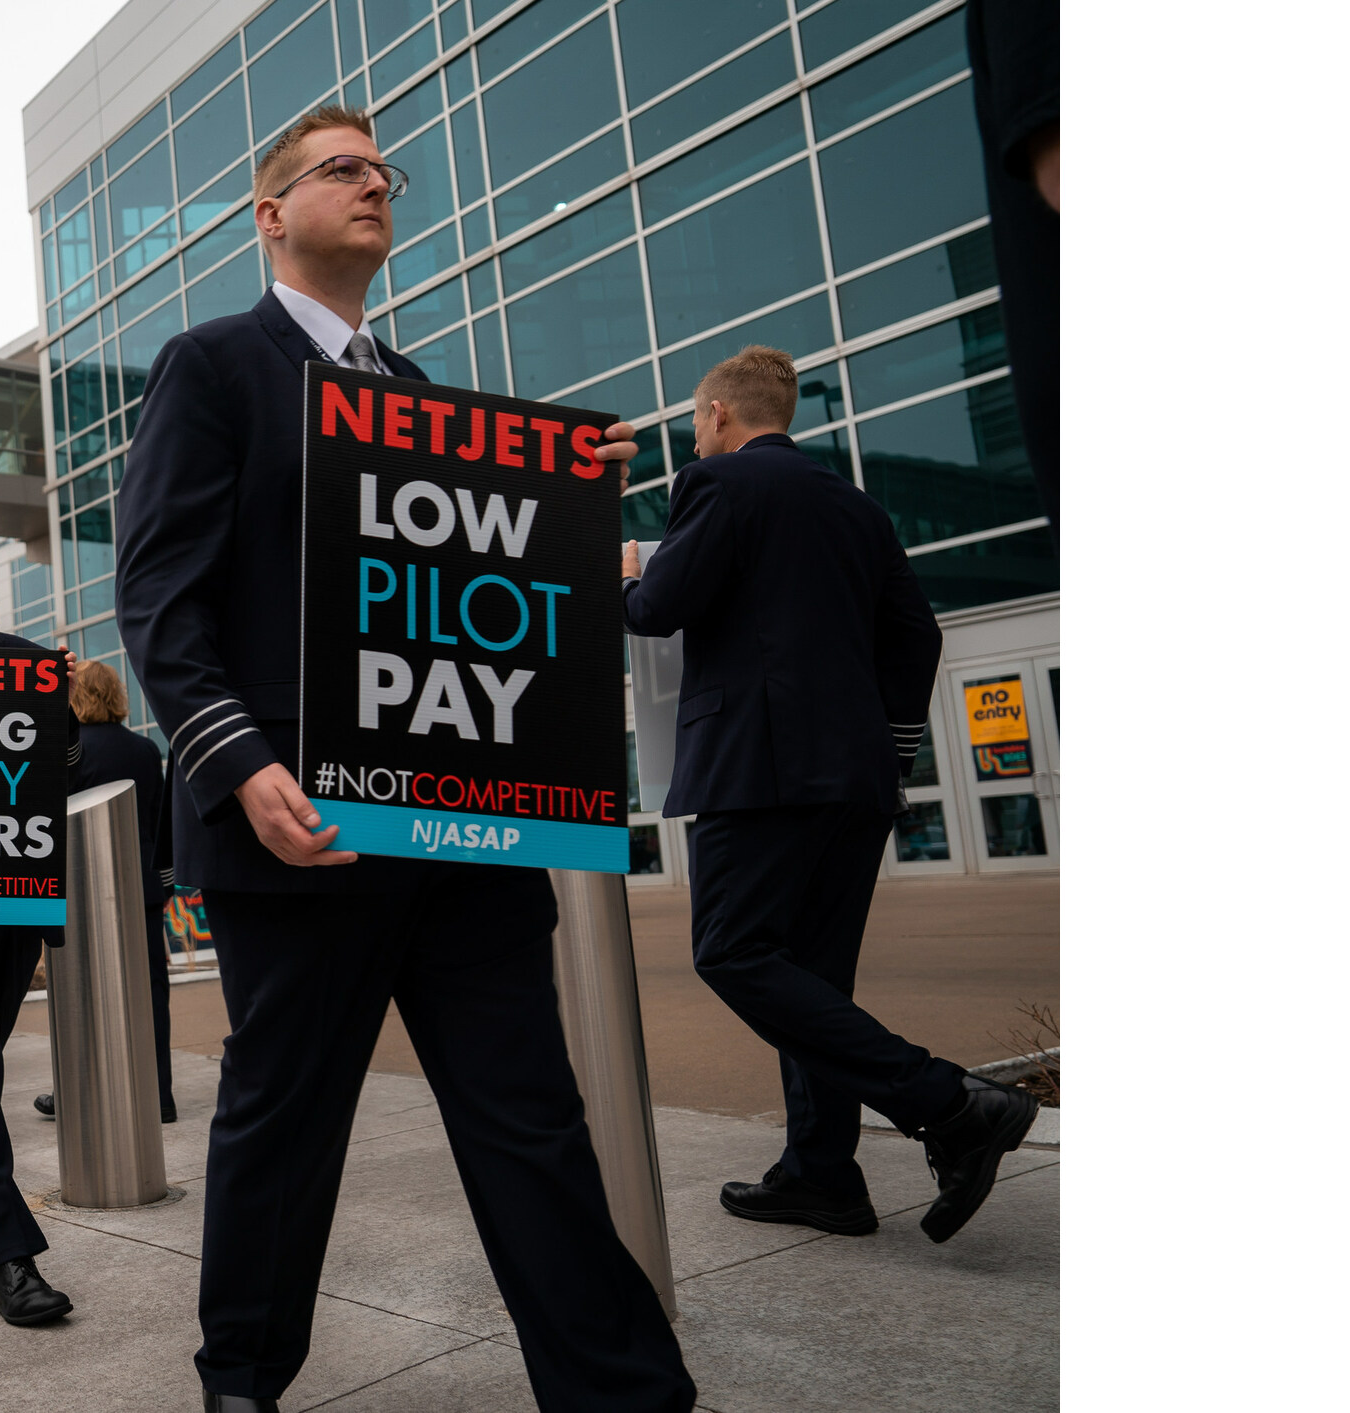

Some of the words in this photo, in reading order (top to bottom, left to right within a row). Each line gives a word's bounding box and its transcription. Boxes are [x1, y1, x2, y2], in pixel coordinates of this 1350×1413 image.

[321, 381, 606, 479] NETJETS
[359, 473, 539, 558] LOW
[359, 556, 571, 657] PILOT
[358, 649, 536, 744] PAY
[973, 704, 1021, 722] entry
[981, 689, 1009, 706] no
[315, 762, 616, 822] #NOTCOMPETITIVE
[411, 819, 521, 852] NJASAP
